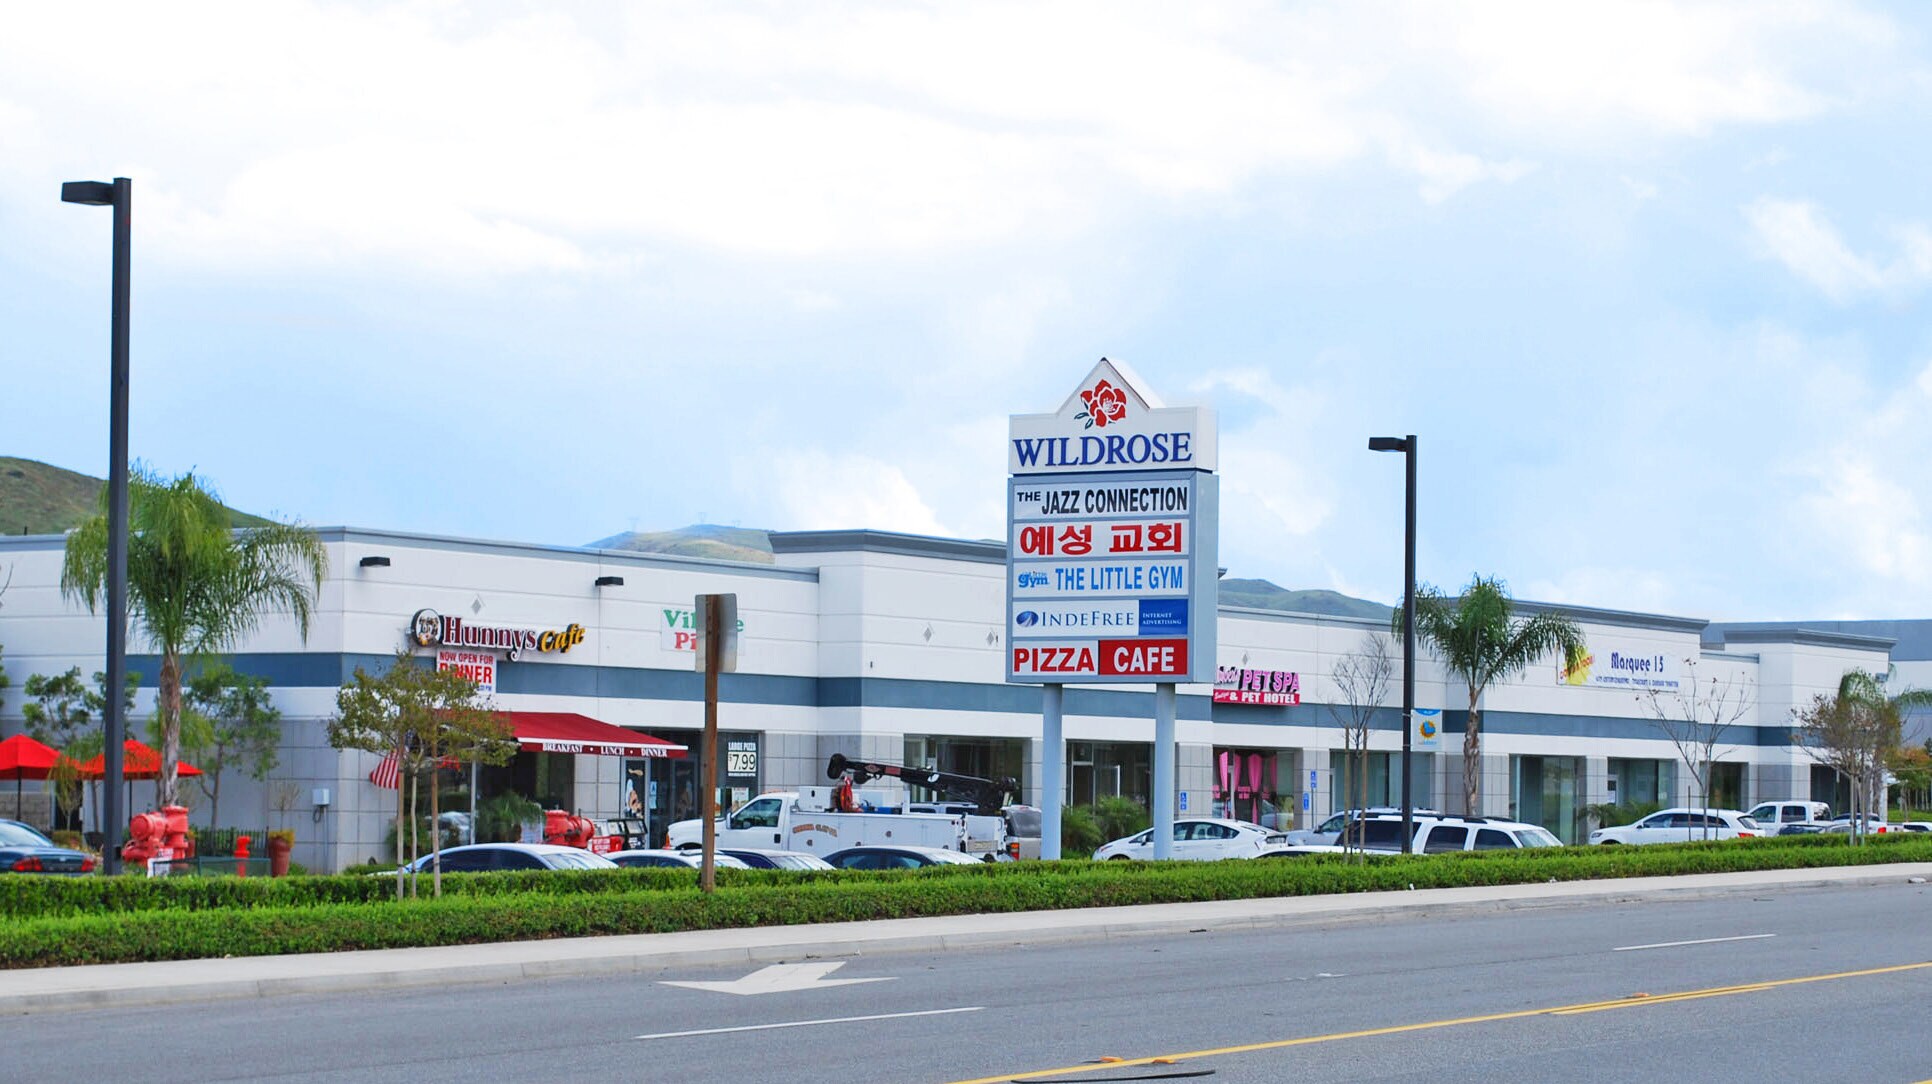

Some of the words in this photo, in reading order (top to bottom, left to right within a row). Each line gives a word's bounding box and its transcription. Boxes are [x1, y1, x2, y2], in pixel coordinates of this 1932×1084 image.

[1012, 432, 1193, 467] WILDROSE
[1017, 491, 1041, 502] THE
[1041, 490, 1080, 515] JAZZ
[1085, 486, 1188, 514] CONNECTION
[1020, 525, 1092, 556] 예성
[1109, 522, 1182, 553] 교회
[1018, 573, 1049, 588] gym
[1055, 567, 1085, 591] THE
[1090, 566, 1143, 590] LITTLE
[1148, 565, 1183, 590] GYM
[663, 609, 744, 632] Vile
[441, 615, 537, 661] Hunnys
[537, 623, 586, 653] Cafe
[440, 651, 456, 661] NOW
[458, 652, 477, 663] OPEN
[480, 654, 493, 664] FOR
[1014, 647, 1095, 672] PIZZA
[1113, 646, 1175, 673] CAFE
[1611, 652, 1651, 674] Marquee
[1654, 655, 1664, 673] 15
[1241, 669, 1271, 690] PET
[1272, 671, 1299, 692] SPA
[1229, 691, 1238, 701] &
[1241, 691, 1263, 702] PET
[1263, 692, 1296, 704] HOTEL
[542, 743, 584, 753] BREAKFAST
[600, 745, 625, 755] LUNCH
[641, 748, 668, 757] DINNER
[728, 753, 756, 770] $7.99
